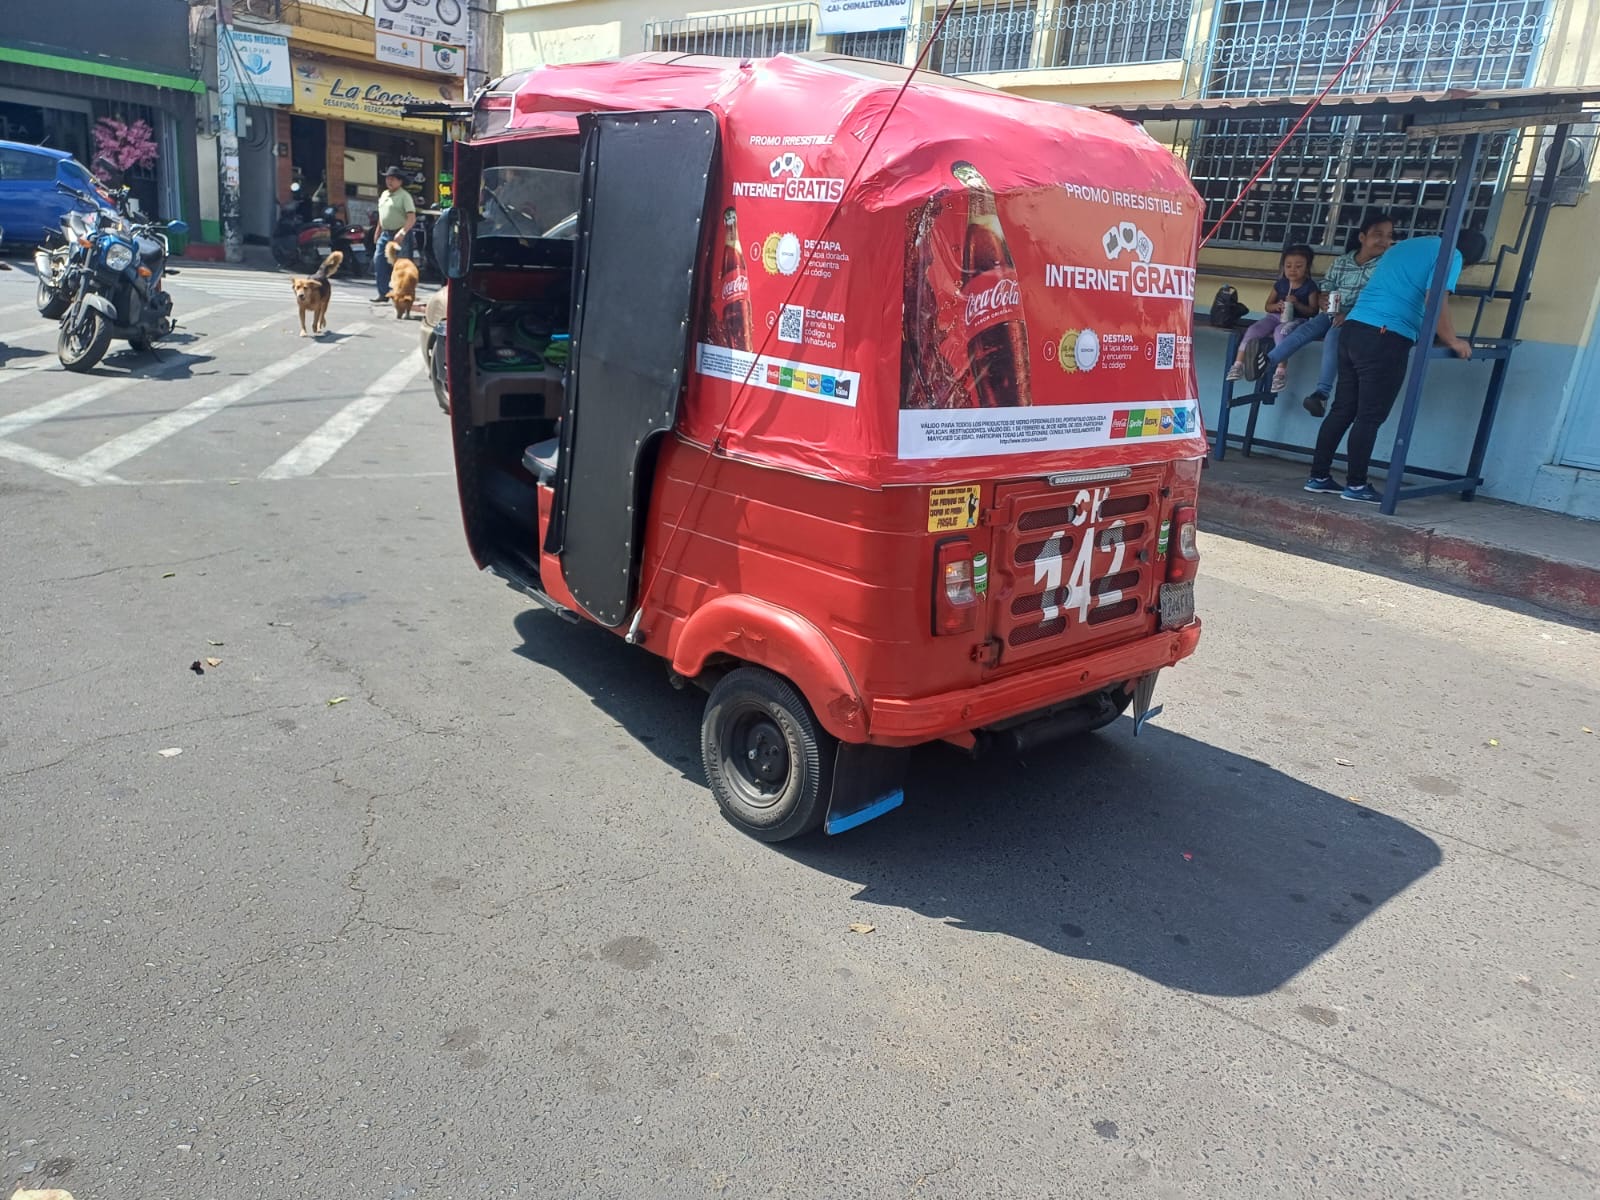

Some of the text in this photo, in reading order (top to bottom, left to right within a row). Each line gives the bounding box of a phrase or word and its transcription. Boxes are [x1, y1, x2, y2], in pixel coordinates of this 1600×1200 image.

[330, 78, 360, 98] La
[323, 98, 359, 111] DESAYUNOS
[749, 135, 781, 146] PROMO
[732, 179, 843, 201] INTERNET GRATIS
[1065, 183, 1184, 217] PROMO IRRESISTIBLE
[804, 239, 841, 251] DESTAPA
[1045, 264, 1130, 292] INTERNET
[965, 278, 1021, 326] Coca-Cola
[805, 308, 846, 323] ESCANEA
[804, 336, 837, 349] WhatsApp
[1103, 334, 1134, 343] DESTAPA
[1033, 519, 1127, 626] 142
